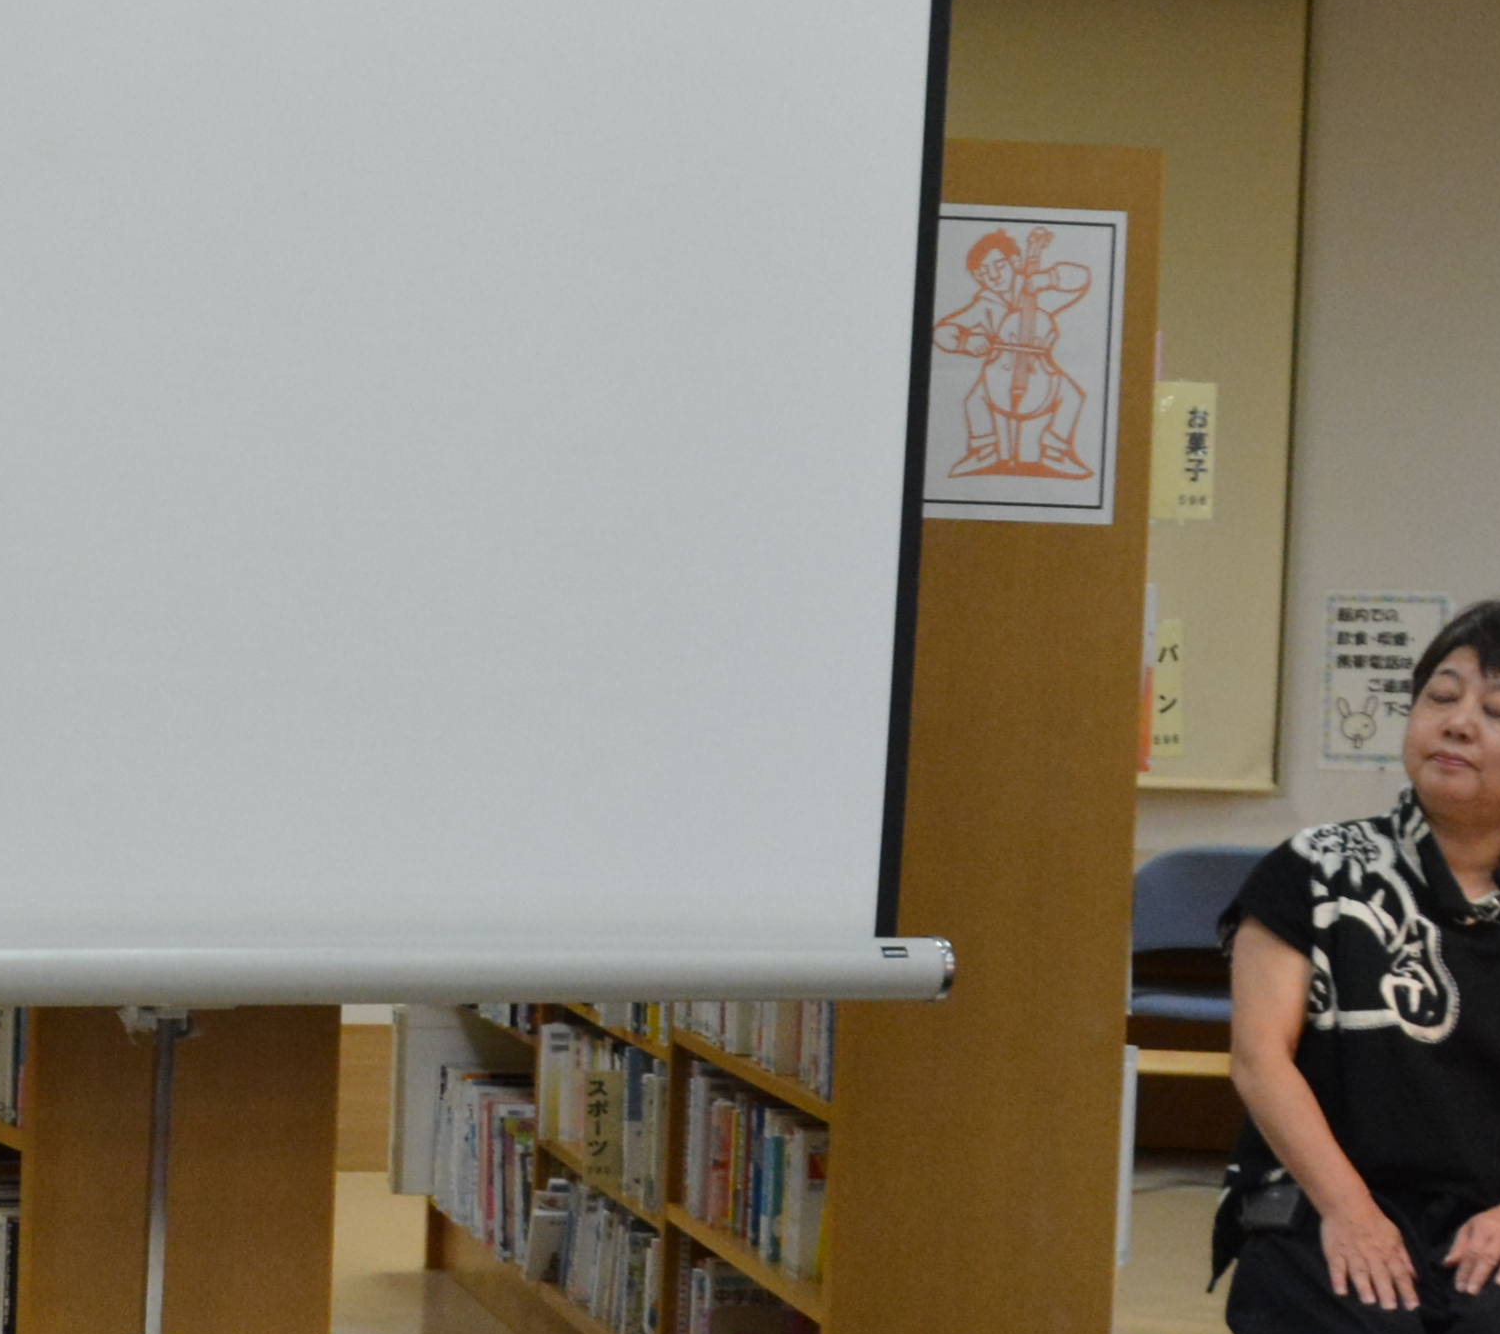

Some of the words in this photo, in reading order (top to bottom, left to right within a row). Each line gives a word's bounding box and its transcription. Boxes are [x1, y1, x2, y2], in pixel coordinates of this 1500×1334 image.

[1184, 406, 1209, 483] お菓子
[1383, 701, 1412, 718] 下さ
[586, 1079, 609, 1157] スポーツ
